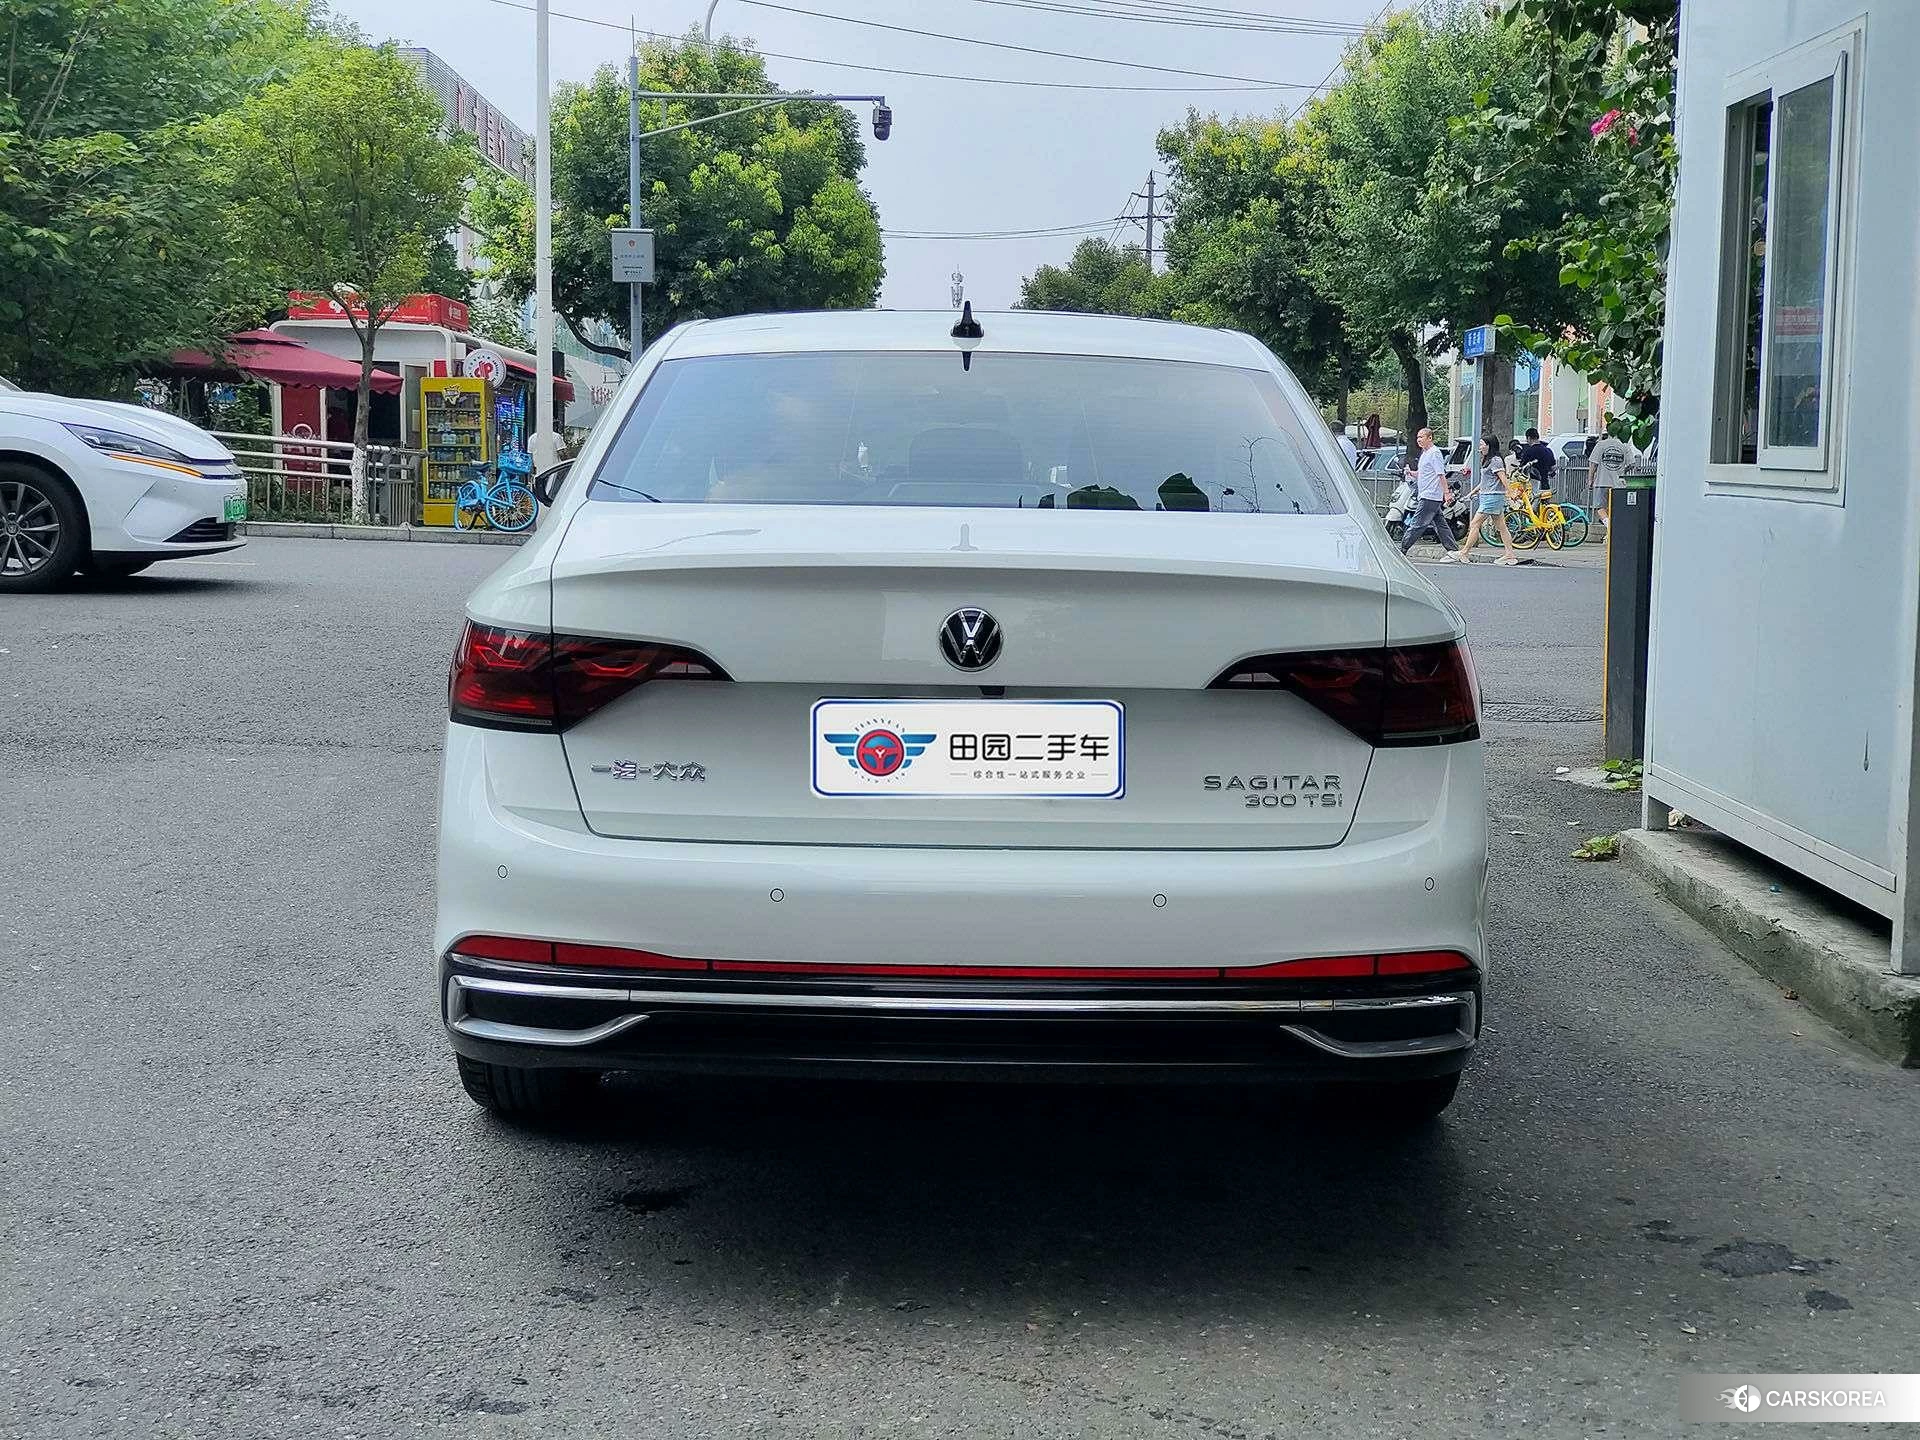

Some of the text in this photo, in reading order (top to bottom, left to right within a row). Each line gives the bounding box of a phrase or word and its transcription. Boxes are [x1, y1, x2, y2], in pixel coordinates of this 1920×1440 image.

[950, 734, 1109, 761] 田园二手车
[973, 770, 1086, 780] 综合性一站式服务企业
[1203, 774, 1342, 791] SAGITAR
[1244, 793, 1298, 808] 300
